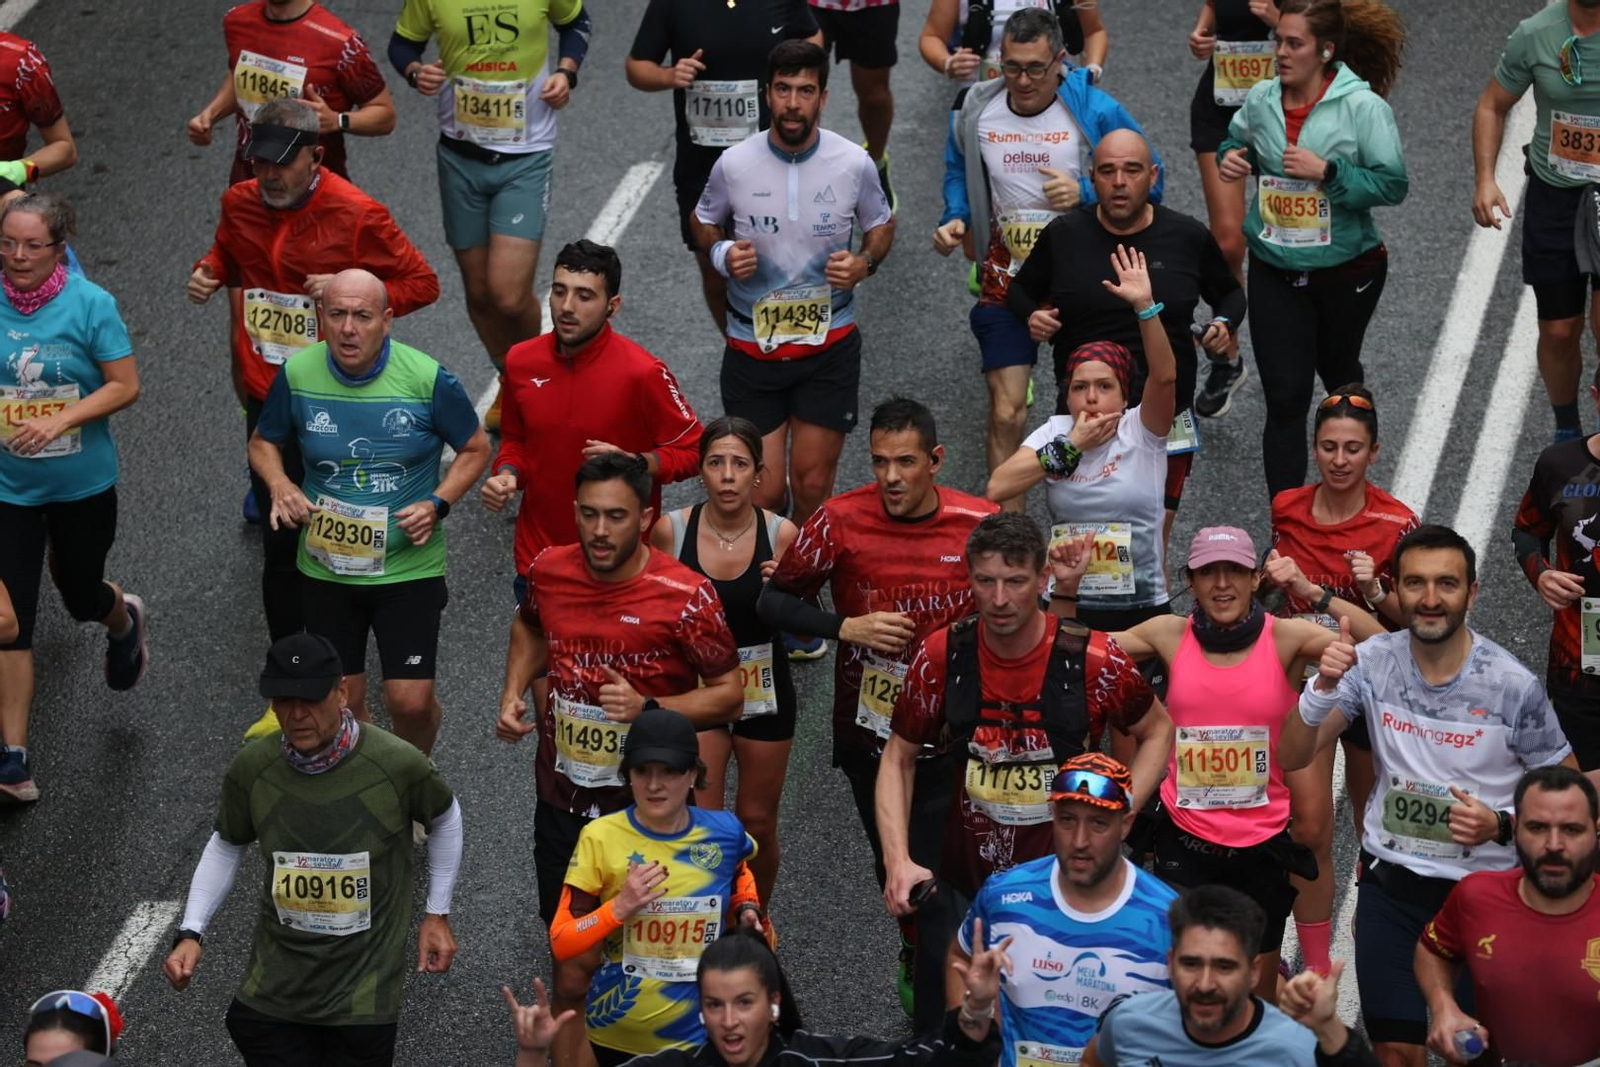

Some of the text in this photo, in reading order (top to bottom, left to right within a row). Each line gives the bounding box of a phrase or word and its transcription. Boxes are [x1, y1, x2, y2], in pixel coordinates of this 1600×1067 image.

[464, 11, 519, 46] ES
[1218, 57, 1272, 78] 11697
[240, 69, 290, 99] 11845
[461, 94, 512, 118] 13411
[693, 97, 746, 117] 17110
[1560, 128, 1600, 152] 383
[1266, 194, 1318, 217] 10853
[813, 223, 837, 231] TEMPO
[251, 306, 306, 335] 12708
[760, 303, 818, 326] 11438
[316, 514, 373, 546] 12930
[292, 656, 300, 664] C
[559, 719, 618, 754] 11493
[1184, 746, 1252, 773] 11501
[976, 762, 1043, 791] 11733
[1394, 796, 1451, 829] 9294
[281, 874, 355, 900] 10916
[1001, 891, 1033, 905] HOKA
[632, 918, 706, 945] 10915
[1032, 958, 1064, 972] LUSO
[1076, 966, 1097, 978] MEIA
[1075, 976, 1117, 993] MARATONA
[1056, 992, 1100, 1010] edp 8K
